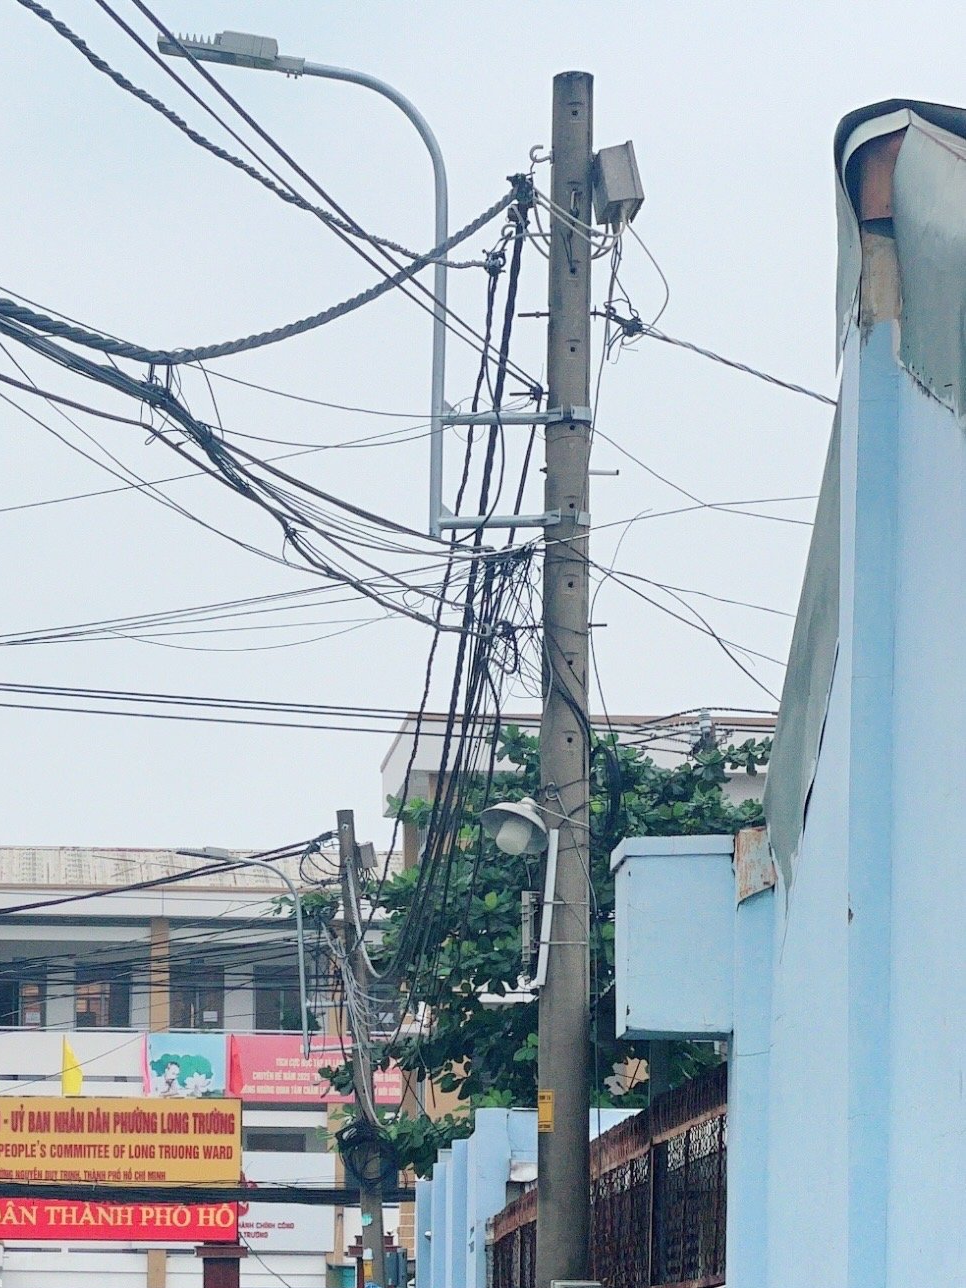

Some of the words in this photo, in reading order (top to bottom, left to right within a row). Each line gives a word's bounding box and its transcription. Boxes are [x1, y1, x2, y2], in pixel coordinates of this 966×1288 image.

[28, 1110, 51, 1133] BAN
[54, 1107, 84, 1133] NHÂN
[87, 1107, 110, 1134] DÂN
[113, 1106, 158, 1134] PHƯỜNG
[161, 1112, 189, 1134] LONG
[192, 1107, 236, 1135] TRƯỜNG
[50, 1143, 110, 1159] COMMITTEE
[113, 1144, 125, 1159] OF
[128, 1144, 156, 1159] LONG
[159, 1145, 200, 1160] TRUONG
[202, 1145, 233, 1160] WARD
[147, 1171, 166, 1181] MINH
[44, 1203, 134, 1226] THÀNH
